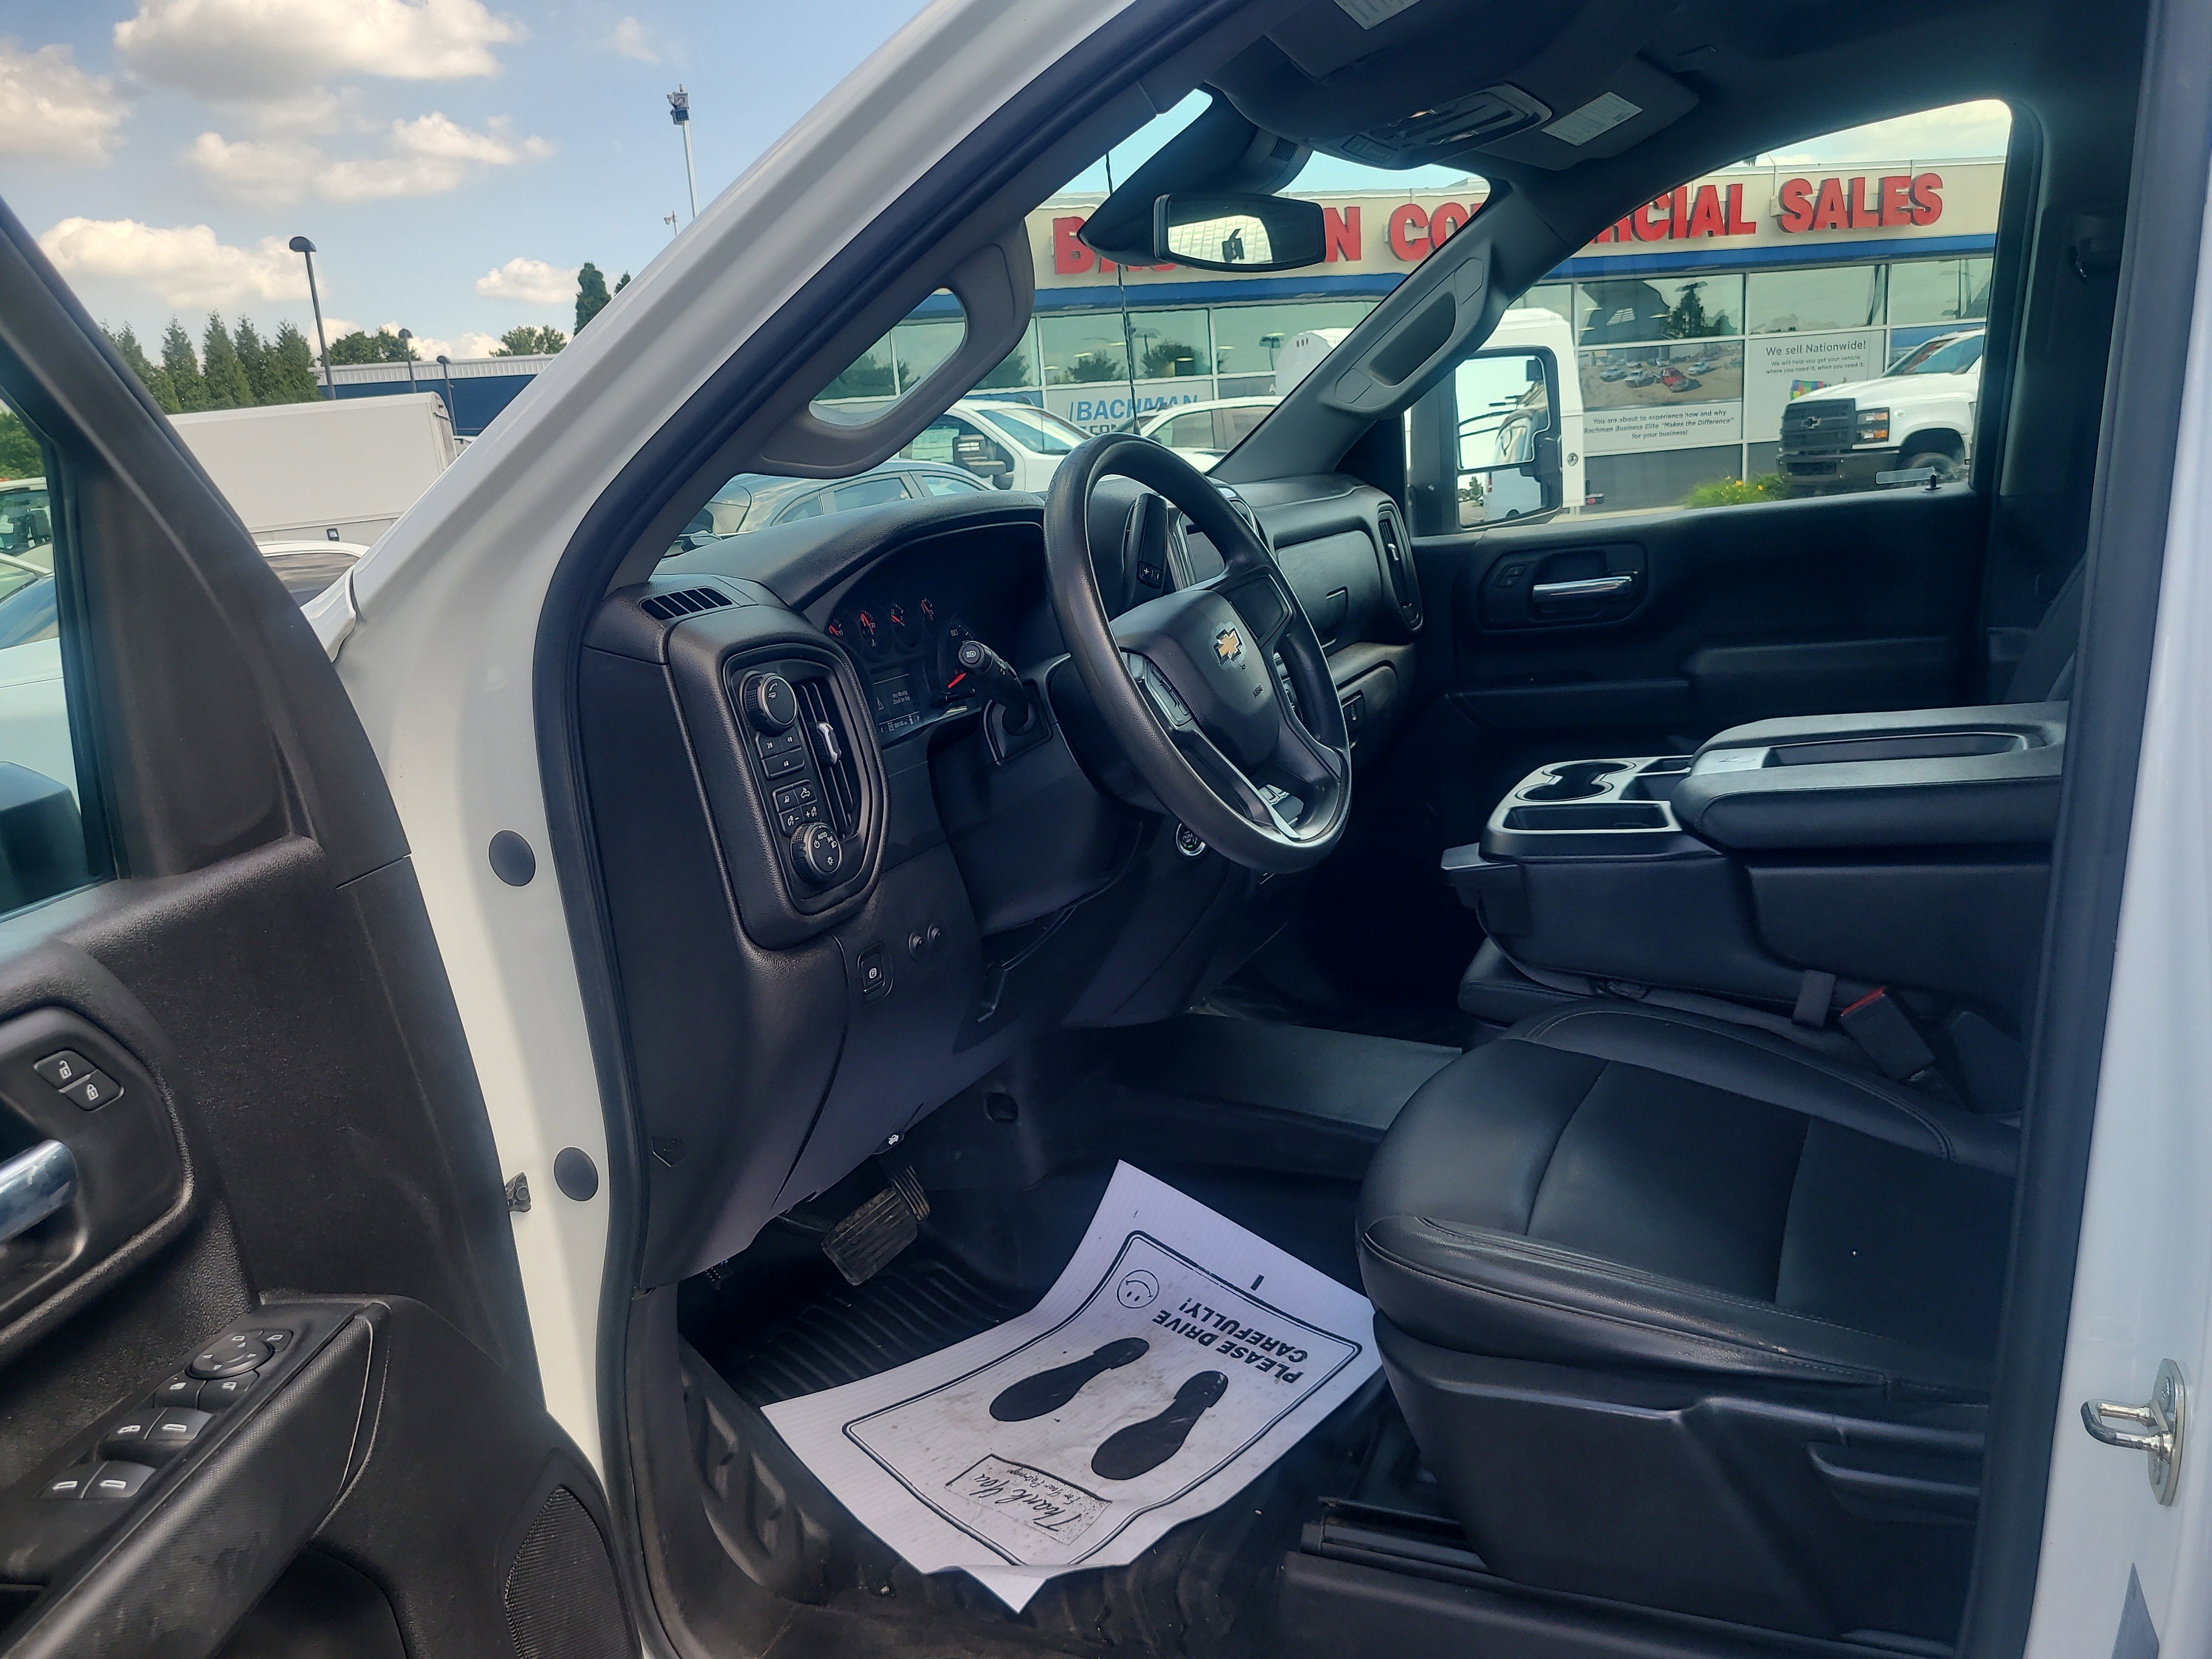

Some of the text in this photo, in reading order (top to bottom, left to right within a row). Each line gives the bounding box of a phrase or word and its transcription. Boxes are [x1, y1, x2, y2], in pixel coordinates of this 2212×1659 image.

[1777, 173, 1943, 233] SALES
[1765, 340, 1866, 356] We sell Nationwide!
[1648, 413, 1683, 421] experience
[1583, 426, 1612, 434] Bachman
[1615, 424, 1643, 432] Business
[1659, 429, 1688, 437] business!
[817, 831, 828, 840] AUTO
[1178, 1297, 1308, 1363] CAREFULLY!
[1152, 1310, 1304, 1384] PLEASE DRIVE
[969, 1474, 1082, 1532] Thank You
